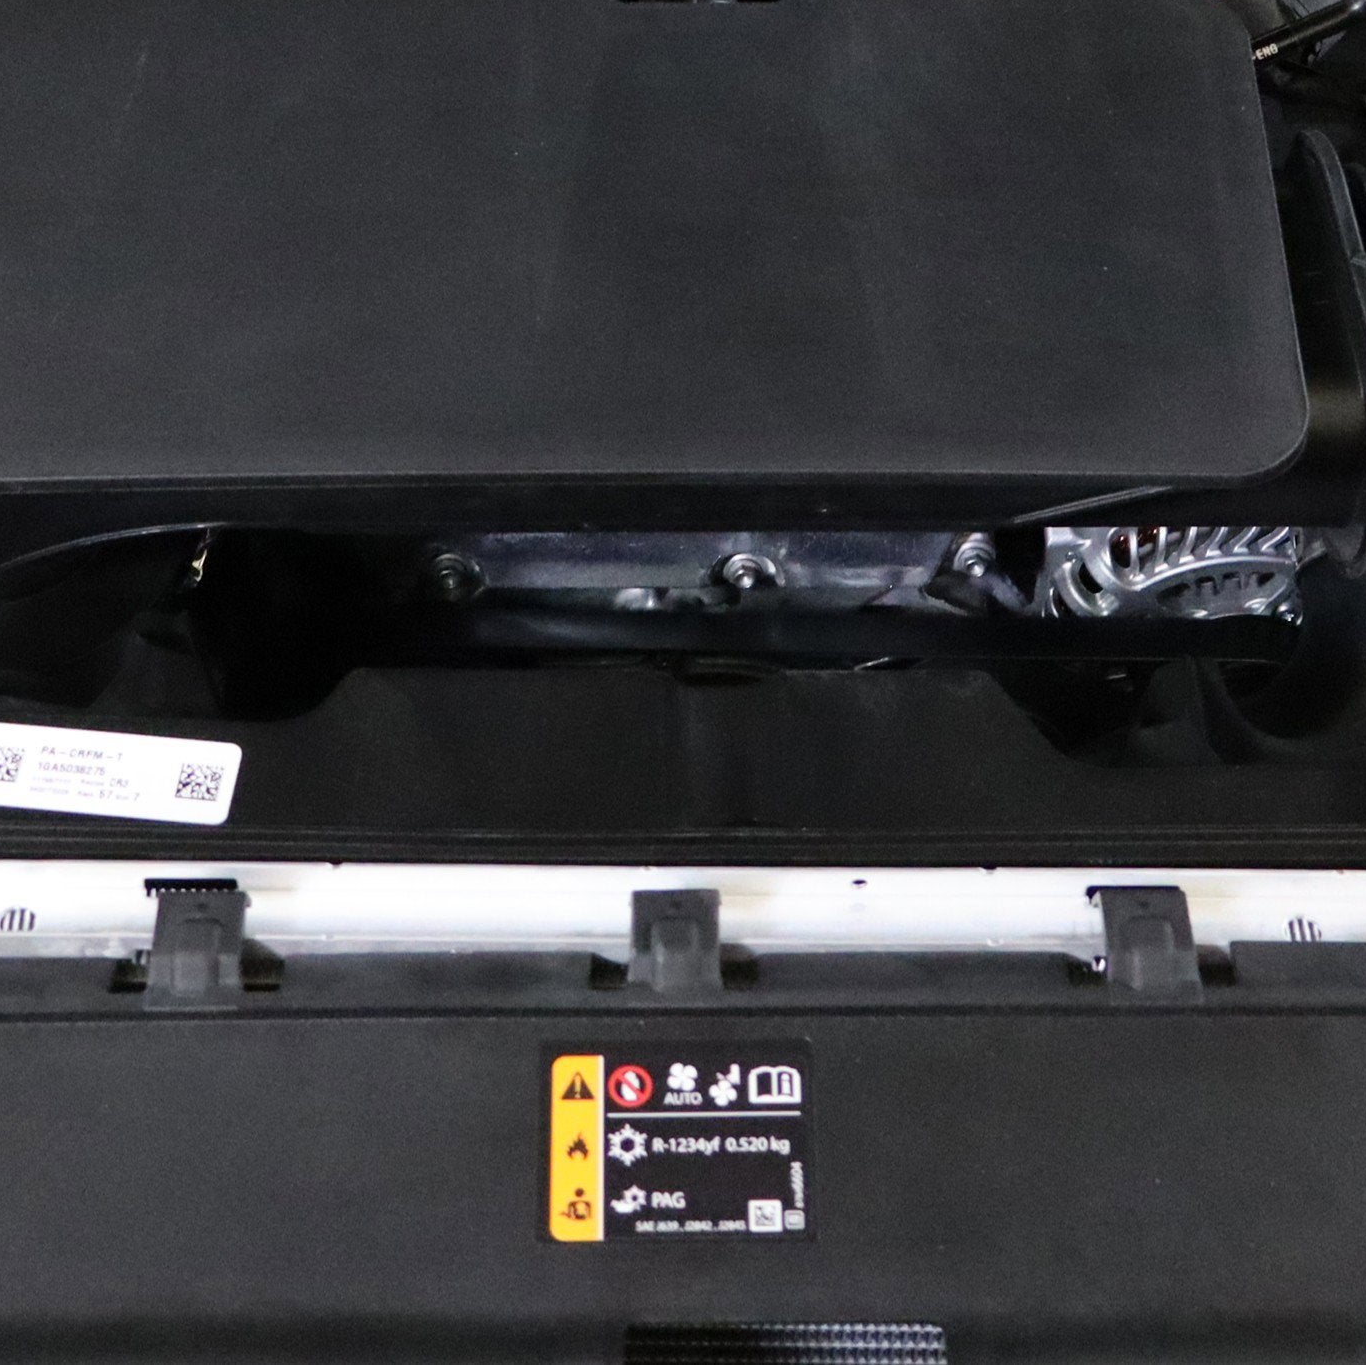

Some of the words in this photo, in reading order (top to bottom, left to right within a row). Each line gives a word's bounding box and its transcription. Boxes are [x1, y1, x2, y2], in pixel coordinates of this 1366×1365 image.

[663, 1092, 702, 1105] AUTO
[652, 1136, 720, 1156] R-1234yf
[725, 1136, 768, 1152] 0.520
[770, 1136, 791, 1156] kg
[651, 1191, 686, 1209] PAG
